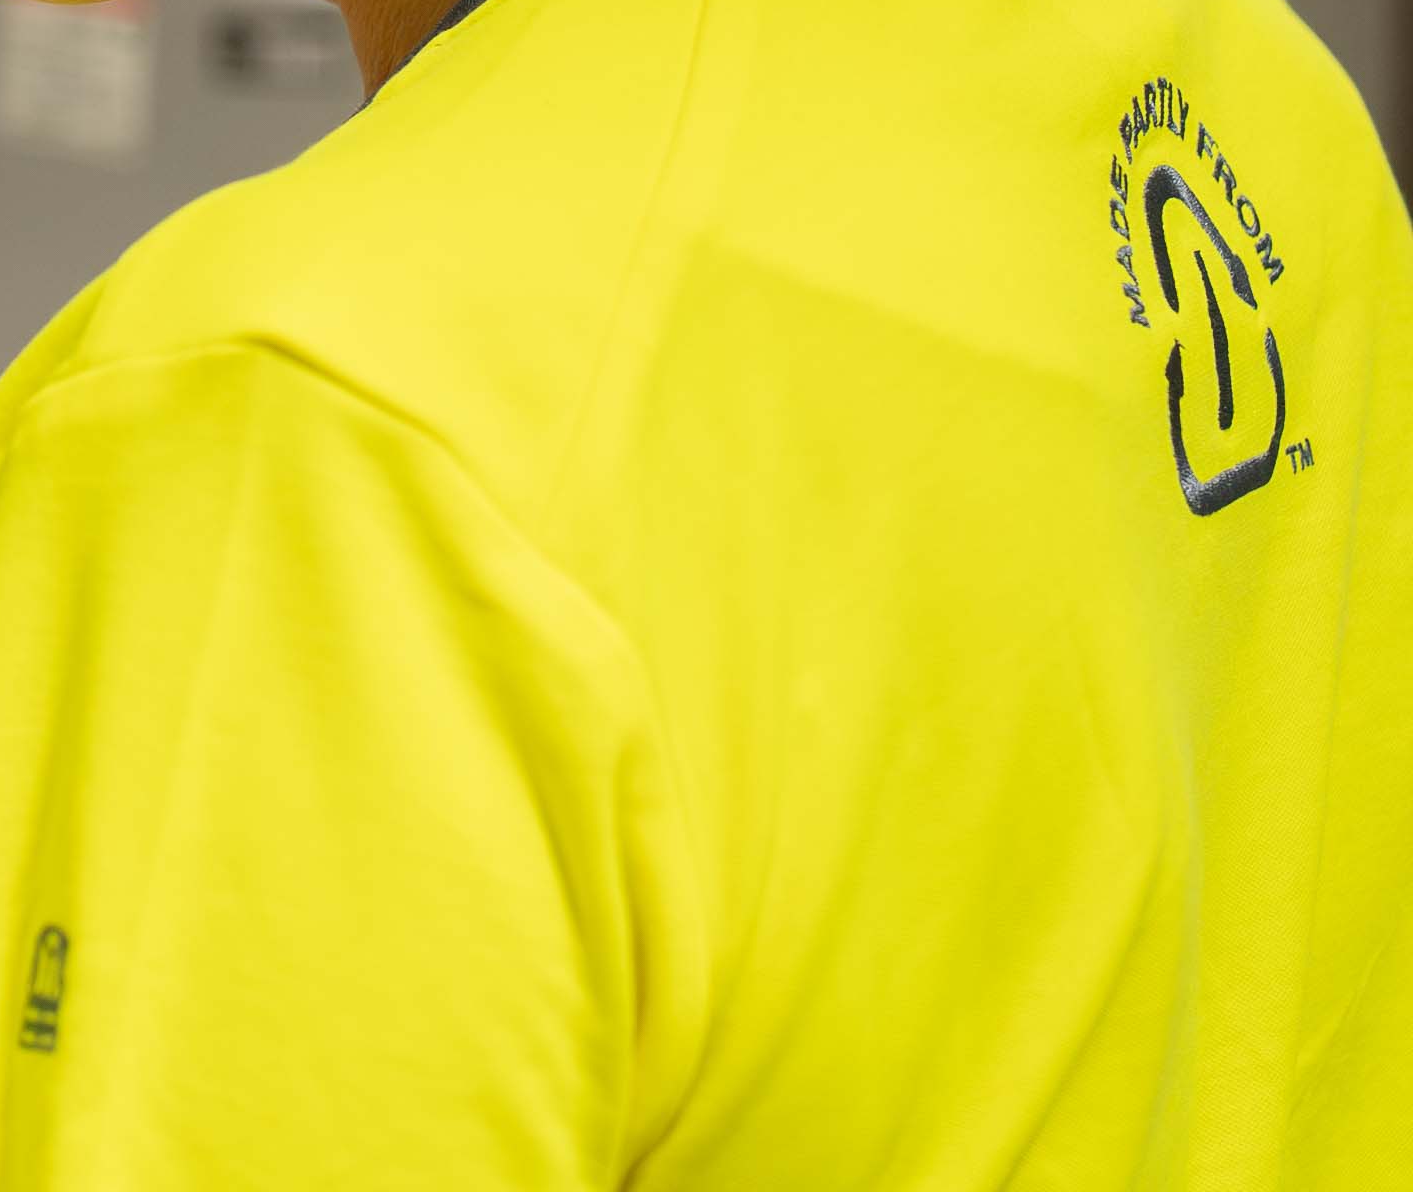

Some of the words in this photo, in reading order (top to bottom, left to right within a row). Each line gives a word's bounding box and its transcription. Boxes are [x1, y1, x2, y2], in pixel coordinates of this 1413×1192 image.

[1119, 76, 1189, 165] PARTLY
[1110, 154, 1150, 328] MADE
[1196, 121, 1285, 285] FROM
[1285, 438, 1316, 474] TM
